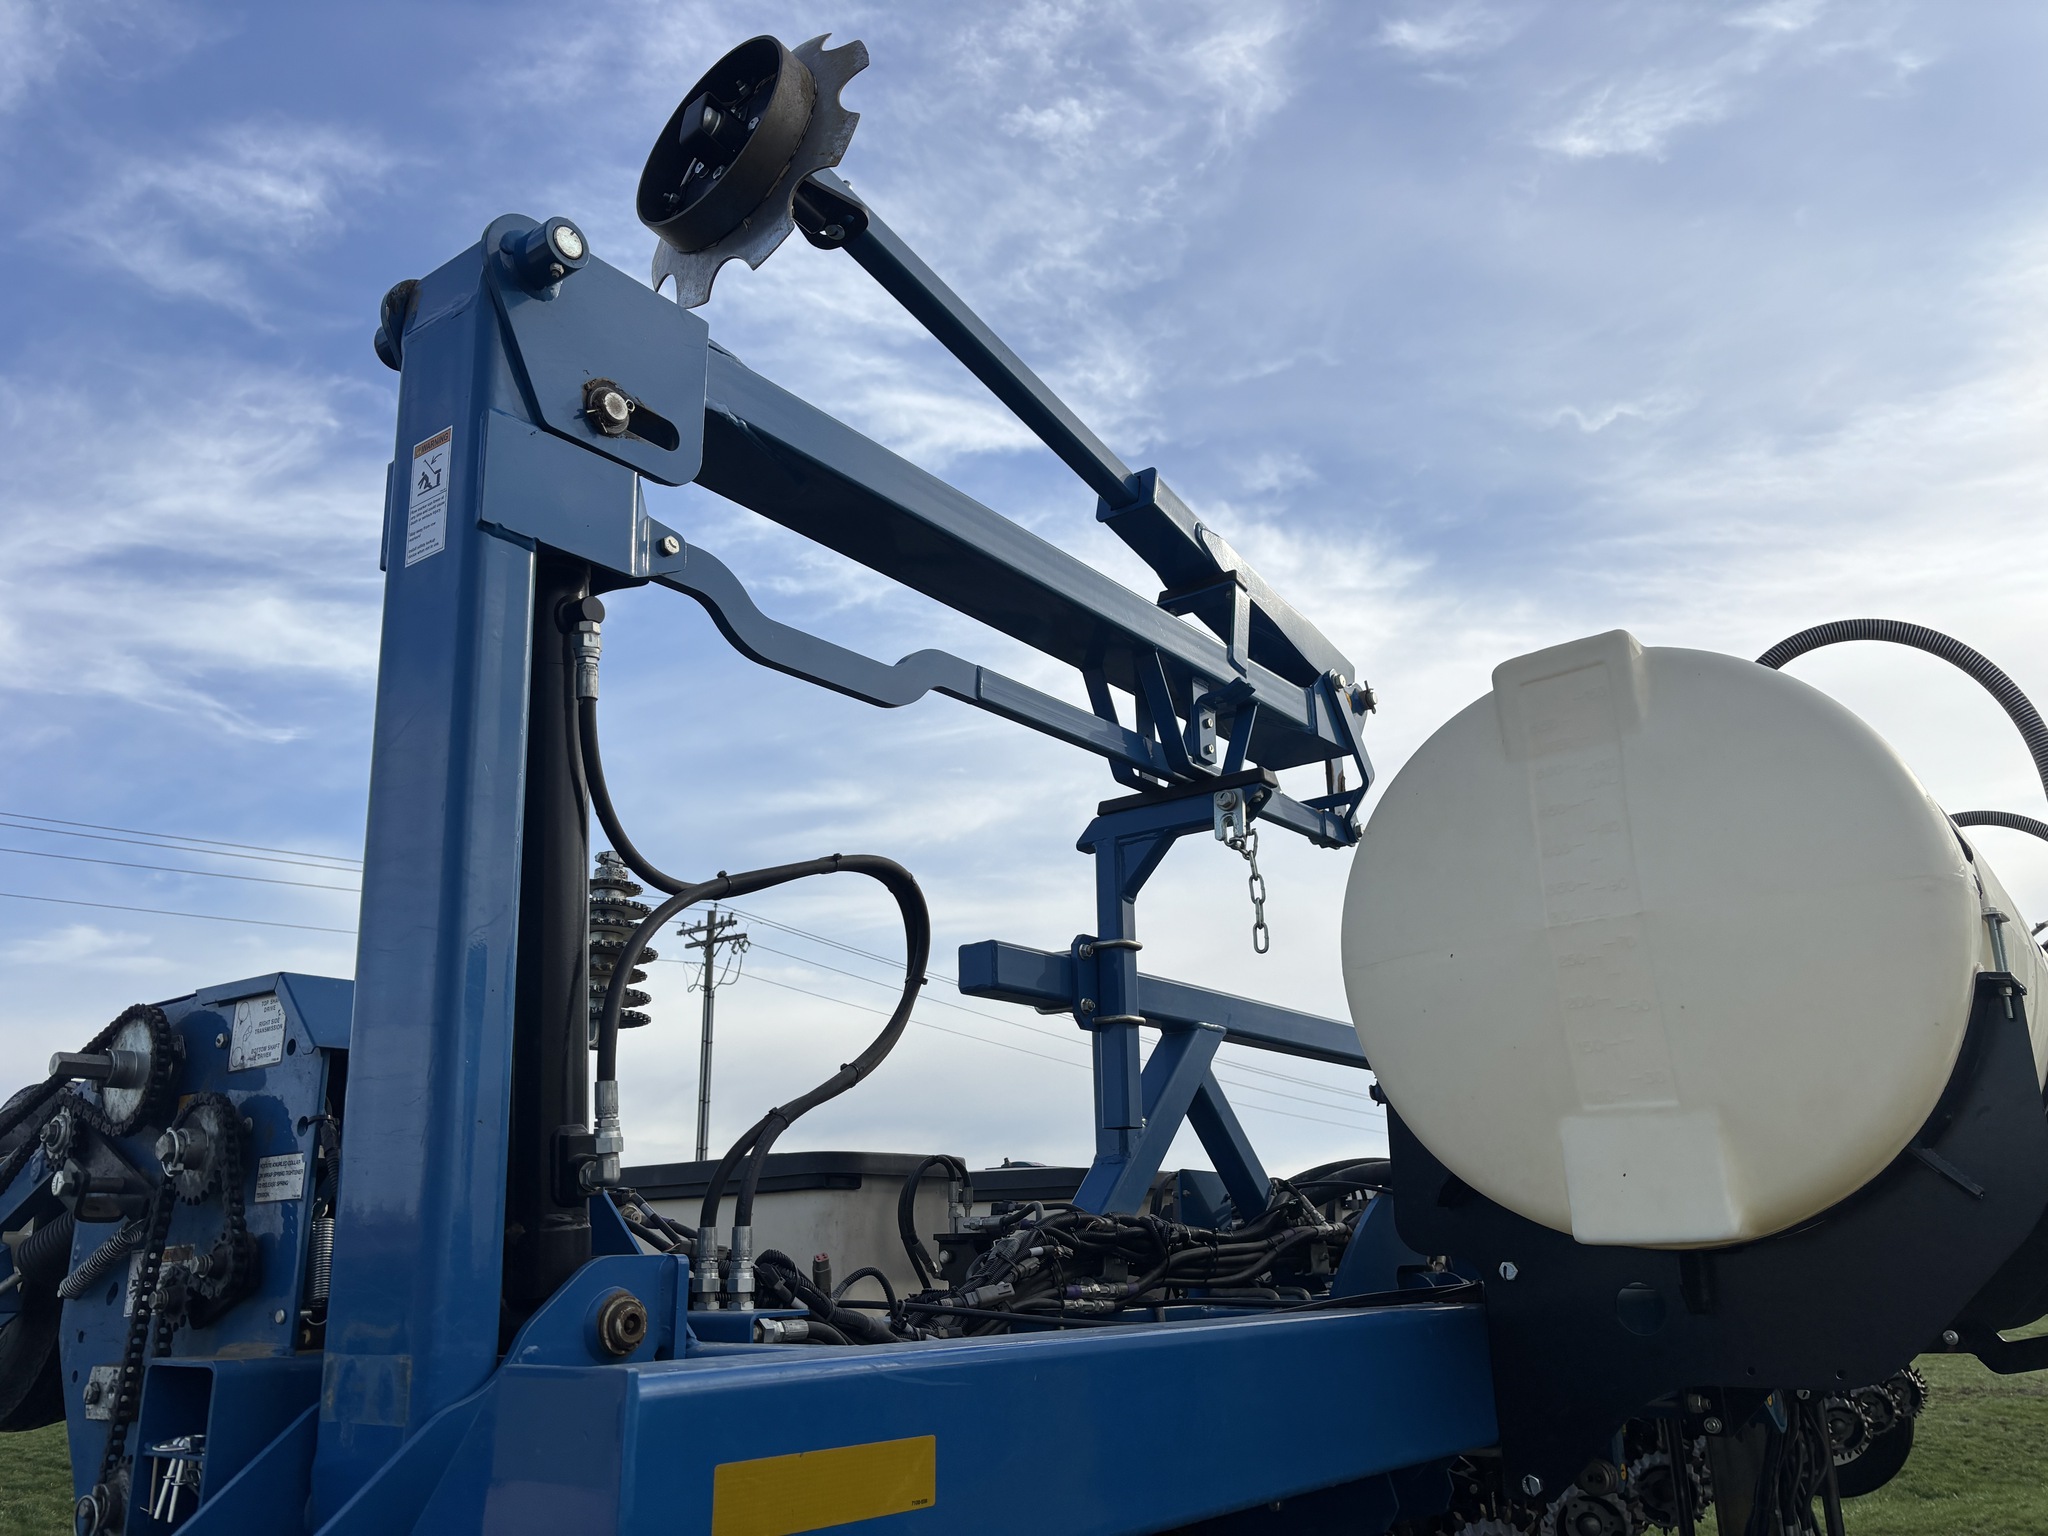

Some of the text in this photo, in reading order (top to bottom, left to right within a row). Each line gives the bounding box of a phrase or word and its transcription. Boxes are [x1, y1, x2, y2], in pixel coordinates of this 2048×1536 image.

[422, 432, 448, 452] WARNING
[255, 1024, 283, 1034] TRANSMISSION
[251, 1046, 267, 1054] BOTTOM
